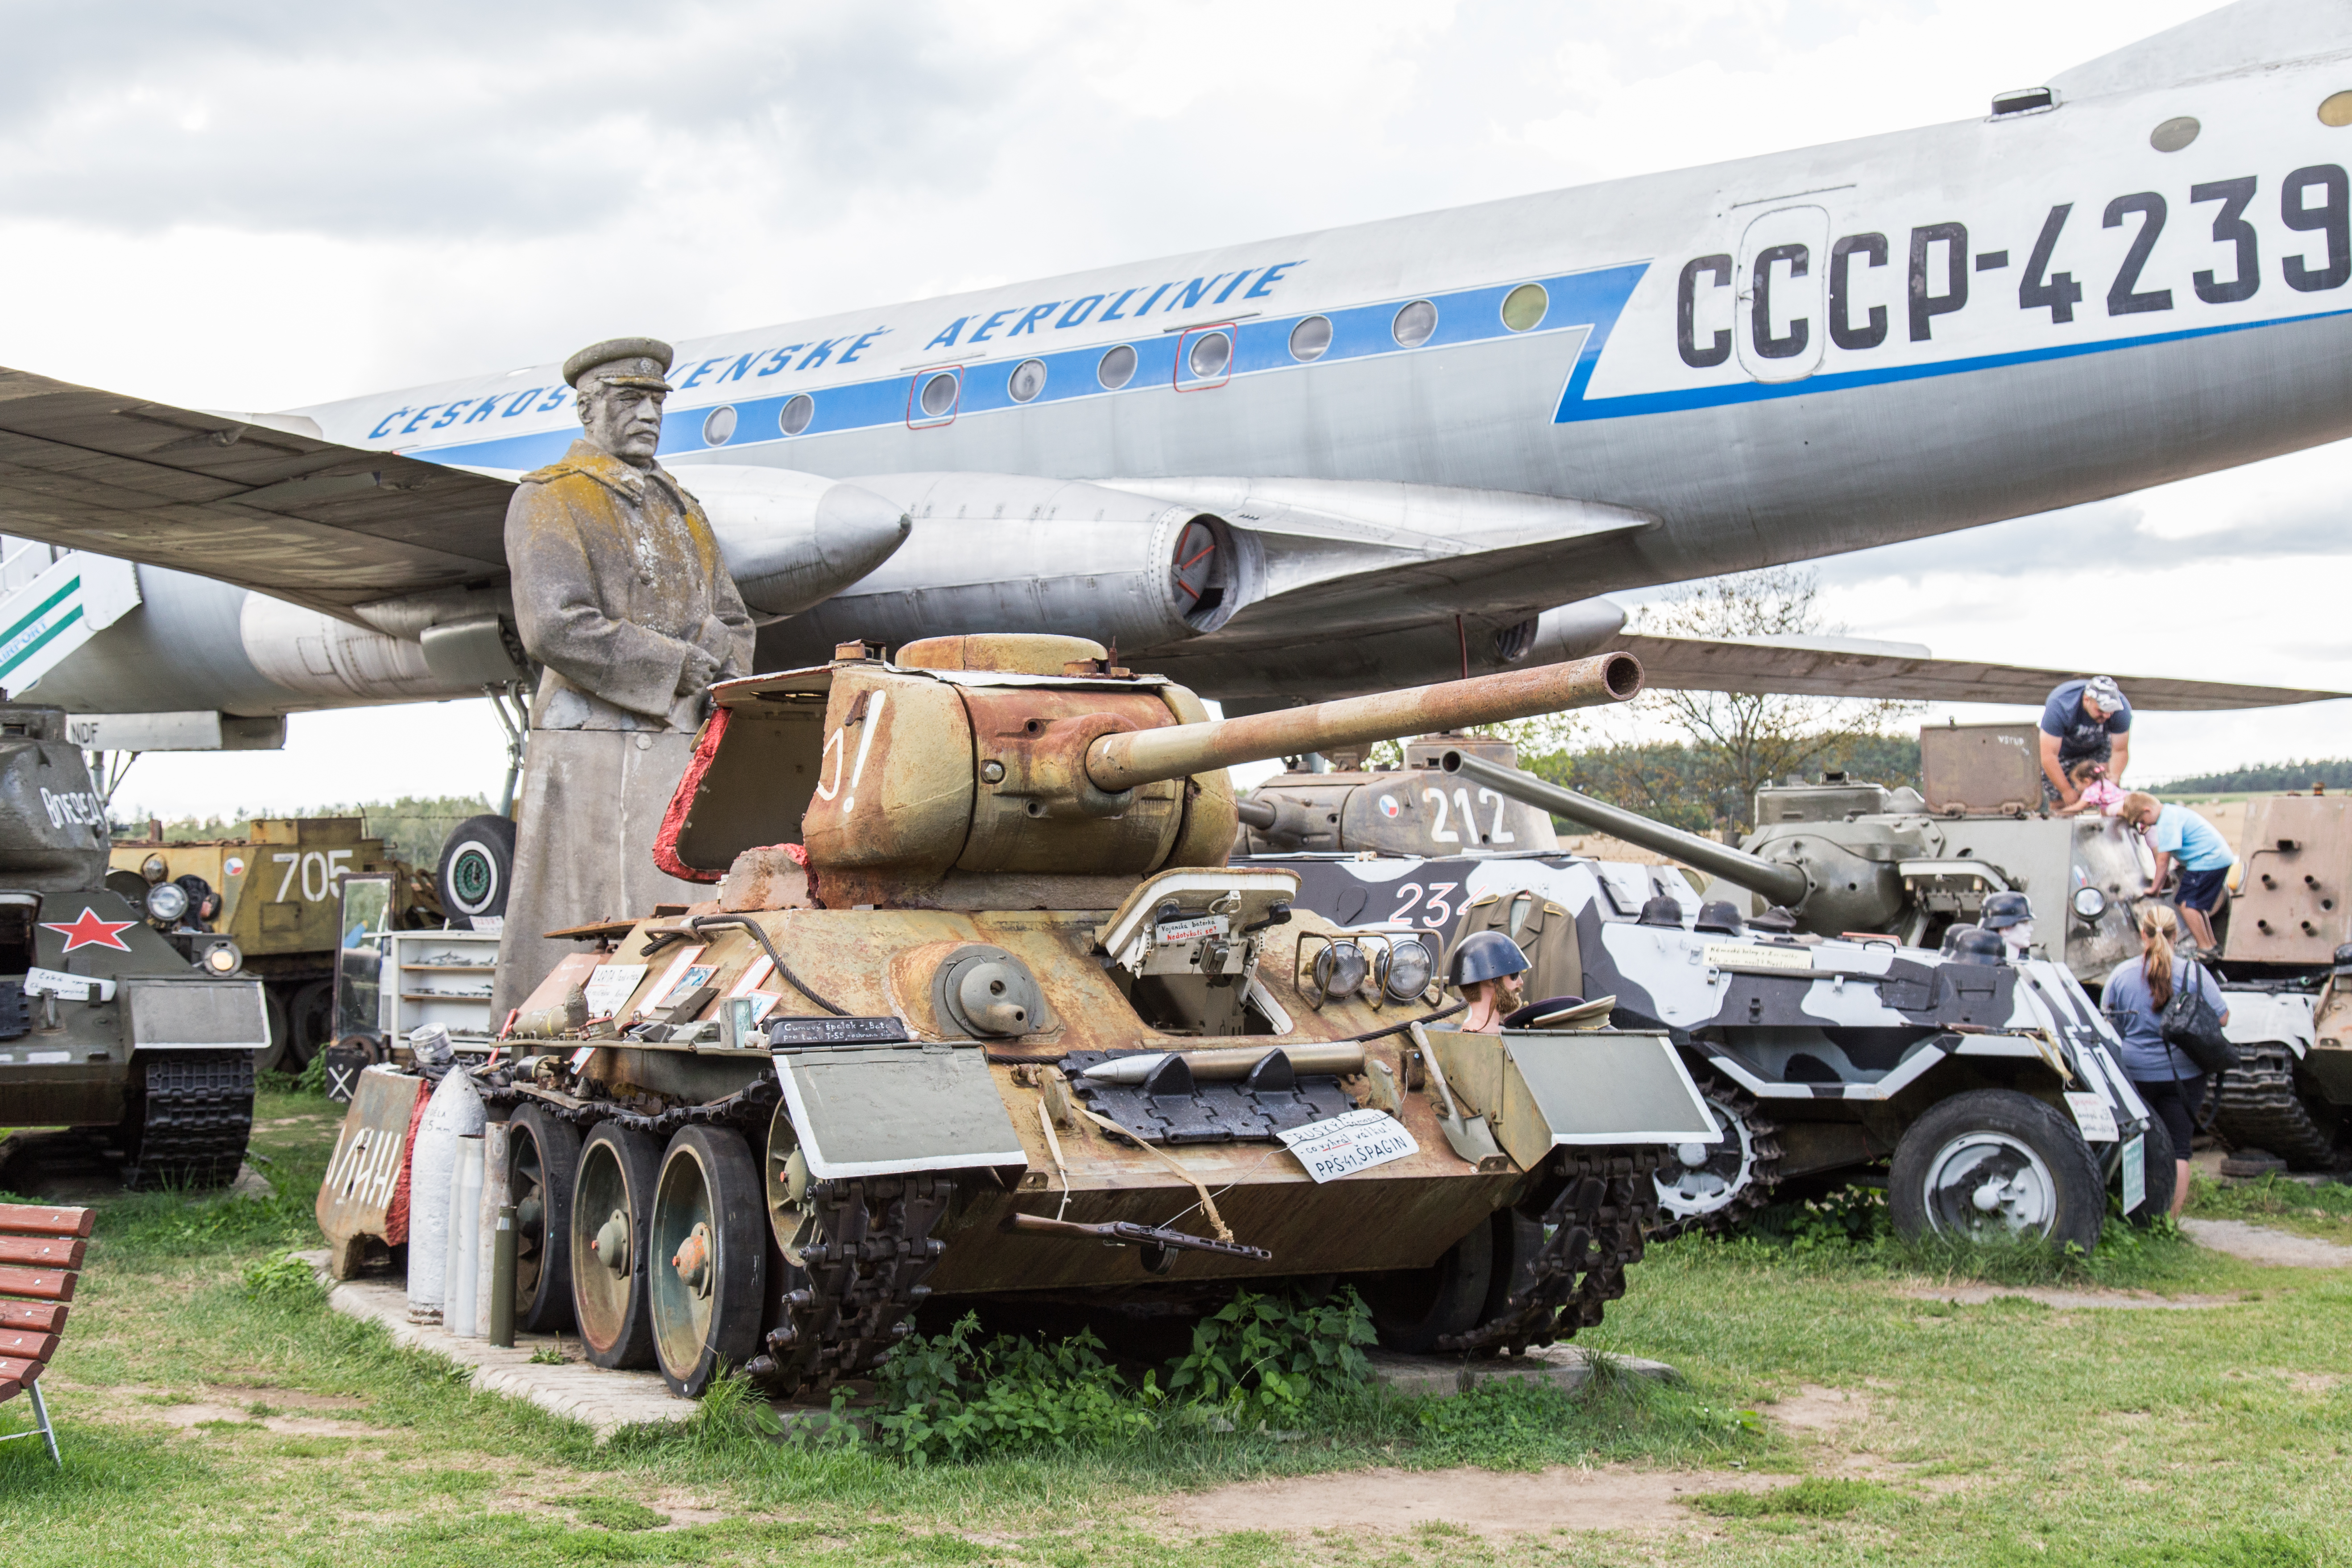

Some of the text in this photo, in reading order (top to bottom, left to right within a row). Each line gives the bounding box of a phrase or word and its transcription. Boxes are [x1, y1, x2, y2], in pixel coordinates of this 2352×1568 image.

[1678, 164, 2351, 368] СССР-4239
[368, 259, 1310, 439] ČESKOSENSKÉ AEROLINIE
[1997, 735, 2024, 746] VSTUP
[1423, 787, 1515, 844] 212
[273, 849, 353, 902] 705
[1161, 923, 1188, 933] Vojenská
[1167, 926, 1217, 941] Nedotýkati se!
[1742, 948, 1759, 956] helmy
[826, 1021, 857, 1031] špalek
[1293, 1121, 1341, 1141] RUSKÝ
[1320, 1134, 1352, 1150] vyhrál
[1355, 1122, 1392, 1139] válku!
